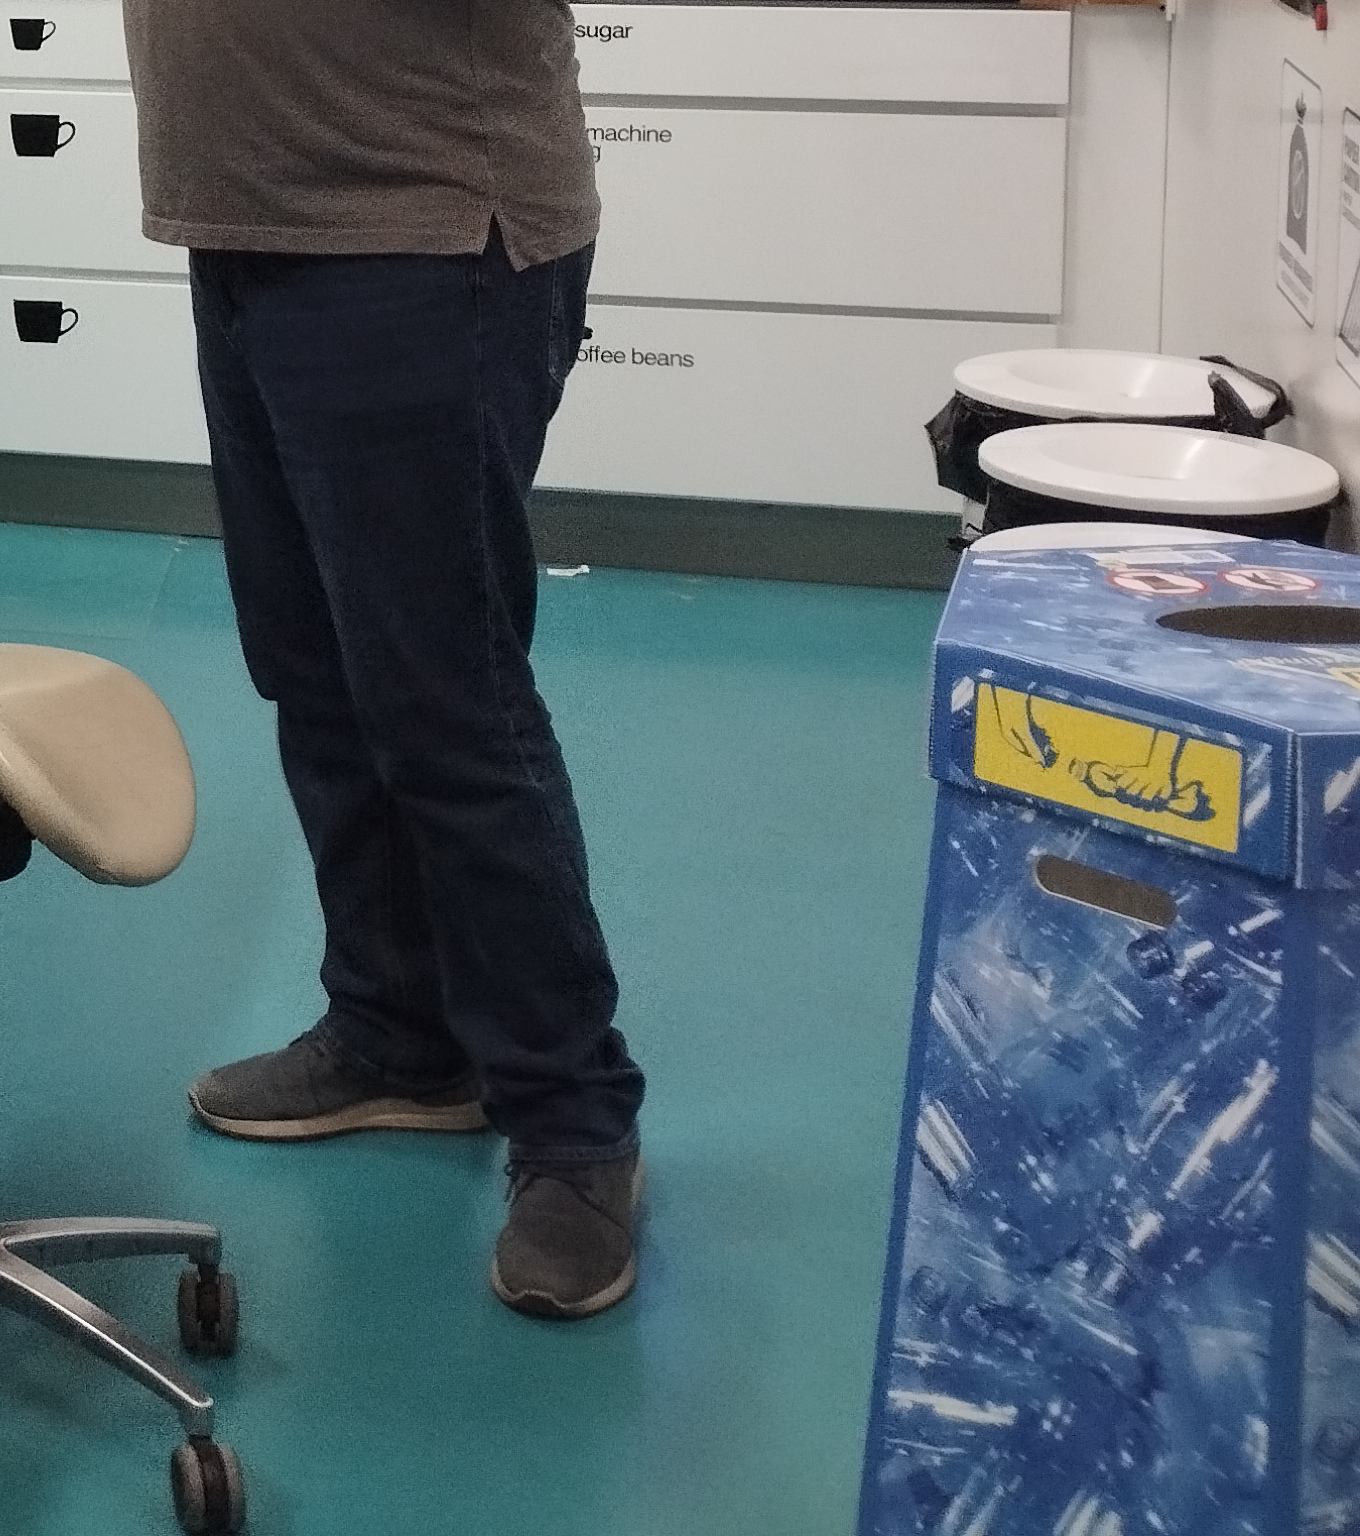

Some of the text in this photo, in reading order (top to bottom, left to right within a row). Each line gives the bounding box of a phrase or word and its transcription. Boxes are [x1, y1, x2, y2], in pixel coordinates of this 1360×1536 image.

[574, 24, 633, 42] sugar
[586, 124, 672, 143] machine
[578, 345, 694, 368] offee beans
